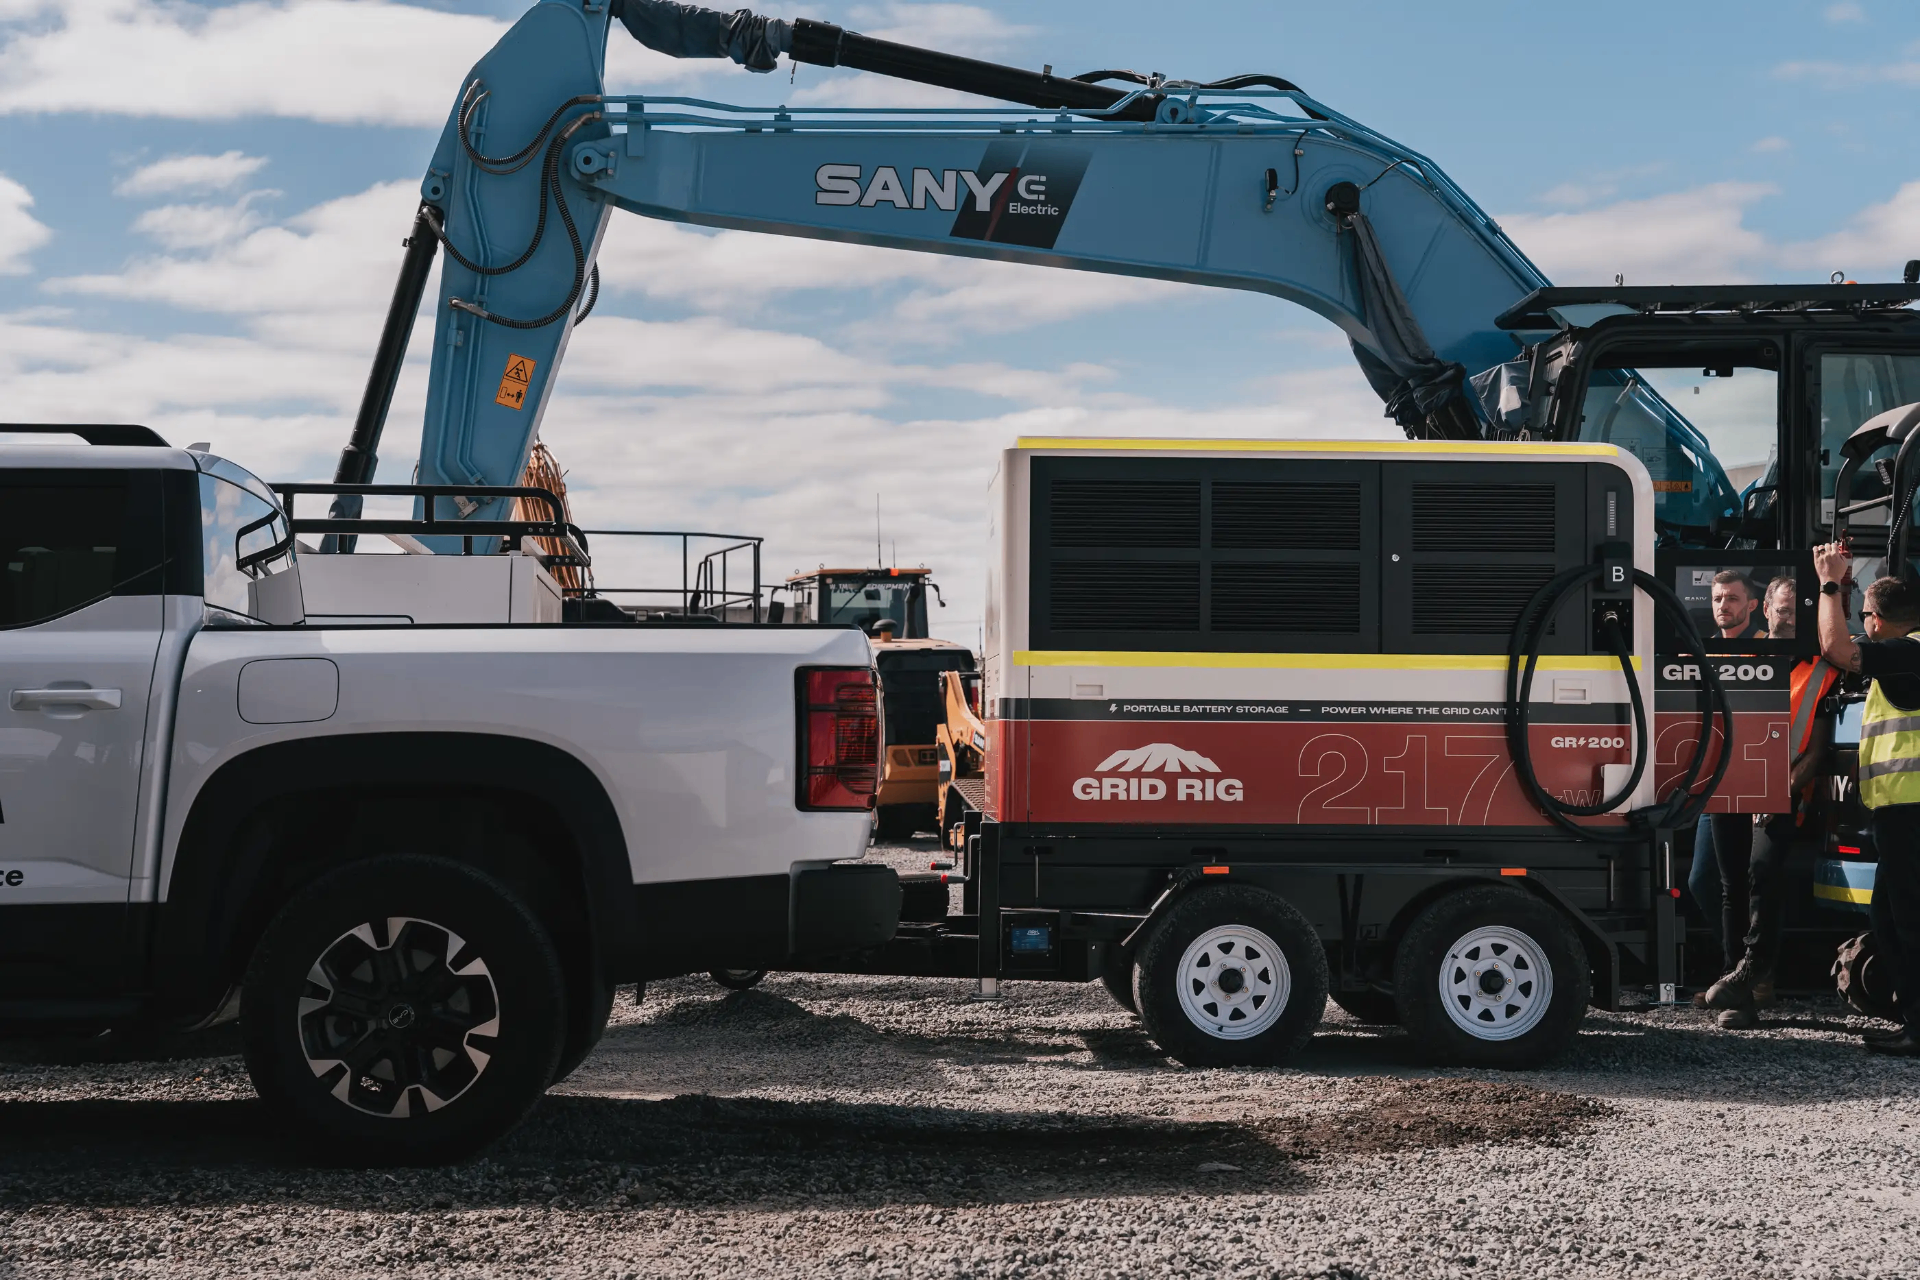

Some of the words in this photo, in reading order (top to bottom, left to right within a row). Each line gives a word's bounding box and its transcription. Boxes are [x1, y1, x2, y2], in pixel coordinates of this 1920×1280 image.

[815, 163, 1010, 212] SANY
[1008, 202, 1060, 216] Electric
[1612, 566, 1625, 582] B
[1123, 705, 1181, 713] PORTABLE
[1182, 705, 1234, 713] BATTERY
[1235, 706, 1289, 714] STORAGE
[1321, 706, 1366, 714] POWER
[1369, 706, 1413, 715] WHERE
[1416, 707, 1440, 715] THE
[1441, 707, 1471, 715] GRID
[1472, 707, 1508, 716] CAN'T
[1072, 777, 1167, 801] GRID
[1177, 778, 1244, 802] RIG
[1297, 733, 1514, 826] 217
